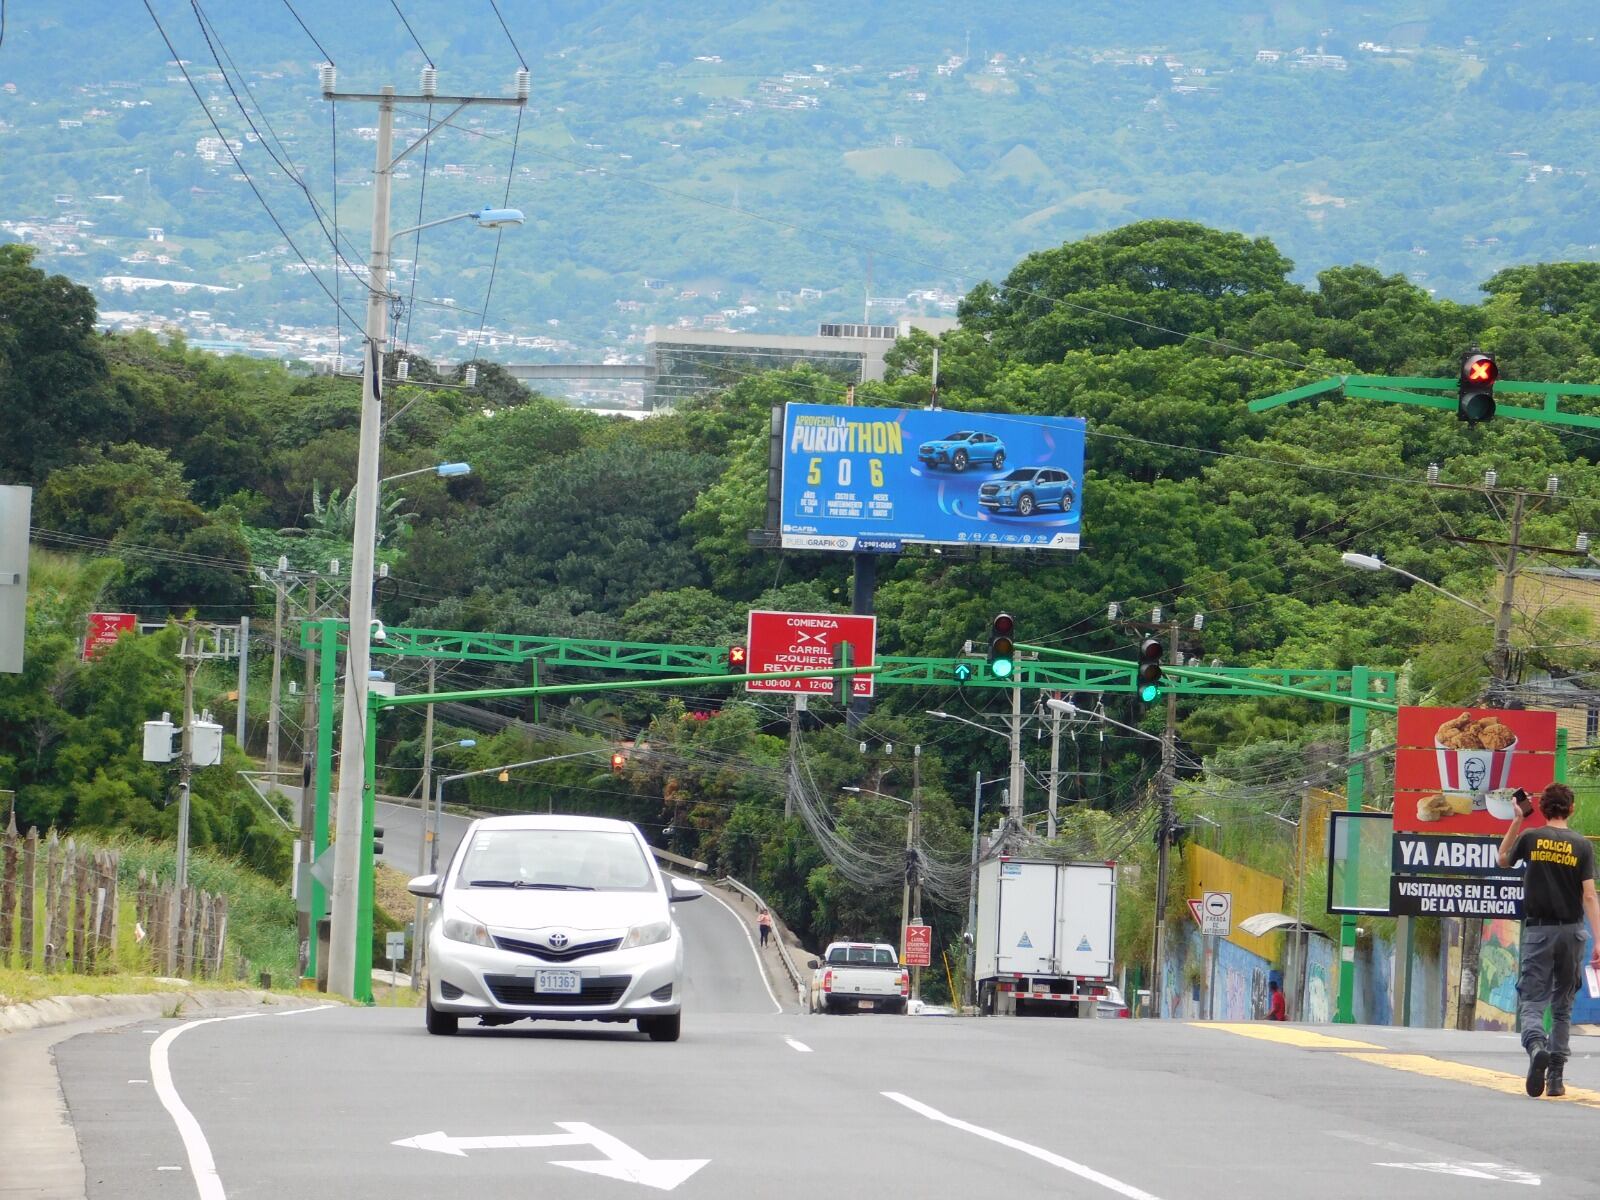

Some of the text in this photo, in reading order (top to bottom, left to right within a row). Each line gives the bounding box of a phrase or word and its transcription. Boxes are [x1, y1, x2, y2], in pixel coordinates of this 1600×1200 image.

[796, 415, 846, 427] APROVECHÁ LA
[791, 420, 903, 454] PURDYTHON
[807, 457, 884, 487] 5 0 6
[786, 618, 839, 628] COMIENZA
[788, 645, 831, 655] CARRIL
[775, 654, 834, 665] IZQUIERD
[765, 680, 791, 688] 00:00
[810, 681, 834, 690] 12:00
[1399, 840, 1429, 866] YA
[1536, 838, 1573, 854] POLICÍA
[1530, 850, 1578, 867] MIGRACIÓN
[1398, 882, 1525, 900] VISITANOS EN EL CRU
[1421, 898, 1516, 915] DE LA VALENCIA
[540, 976, 576, 988] 911363
